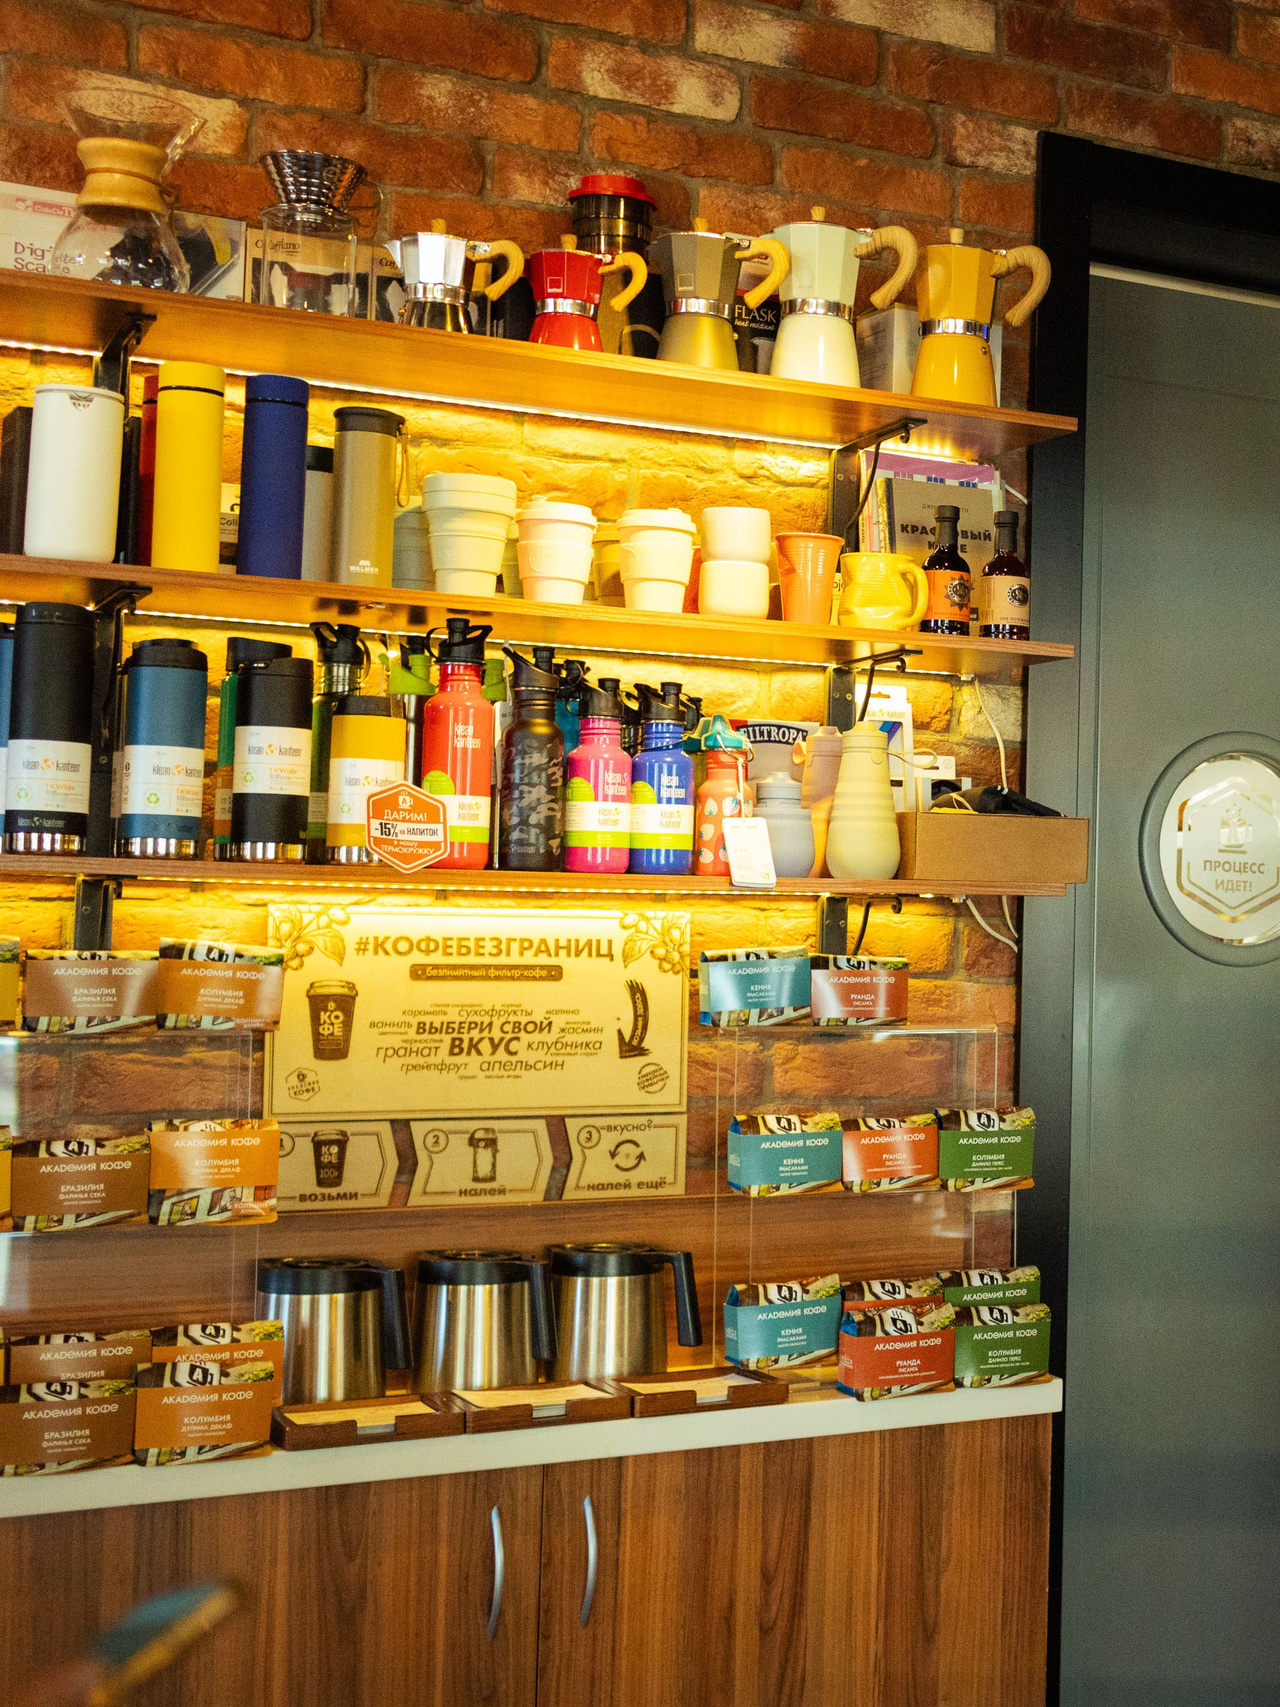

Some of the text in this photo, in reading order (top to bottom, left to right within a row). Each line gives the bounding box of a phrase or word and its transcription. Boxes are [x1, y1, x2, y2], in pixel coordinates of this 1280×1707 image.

[735, 305, 777, 323] FLASK
[900, 523, 992, 542] КРАФВЫЙ
[927, 540, 968, 553] КЕ
[350, 565, 378, 574] WALMER
[454, 722, 474, 736] klean
[453, 735, 482, 749] kanteen
[247, 744, 303, 759] klean kanteen
[22, 757, 40, 771] klean
[152, 763, 171, 777] klean
[344, 775, 361, 787] klean
[604, 770, 622, 784] klean
[660, 773, 679, 787] klean
[604, 783, 627, 796] kanteen
[660, 787, 686, 799] kanteen
[383, 809, 428, 822] ДАРИМ!
[374, 821, 399, 838] -15%
[406, 827, 439, 837] НАПИТОК
[381, 844, 435, 855] ТЕРМОКРУЖКУ
[1203, 859, 1266, 874] ПРОЦЕСС
[1214, 879, 1253, 893] ИДЕТ!
[354, 936, 615, 962] #КОФЕБЕЗГРАНИЦ
[425, 965, 548, 980] безлимитный фильтр-кофе
[73, 987, 117, 995] БРАЗИЛИЯ
[200, 988, 244, 998] КОЛУМБИЯ
[320, 1010, 344, 1024] КО
[402, 1008, 448, 1019] карамель
[458, 1004, 534, 1021] сухофрукты
[545, 1007, 580, 1016] малина
[318, 1023, 343, 1036] ФЕ
[369, 1020, 413, 1030] ваниль
[415, 1020, 494, 1035] ВЫБЕРИ
[499, 1016, 553, 1035] СВОЙ
[558, 1024, 604, 1035] жасмин
[375, 1035, 604, 1064] гранат ВКУС клубника
[400, 1058, 565, 1075] грейпфрут апельсин
[606, 1119, 653, 1136] вкусно?
[432, 1134, 441, 1145] 2
[321, 1144, 339, 1154] КО
[195, 1158, 240, 1167] КОЛУМБИЯ
[321, 1153, 339, 1164] ФЕ
[972, 1153, 1005, 1161] КОЛУМБИЯ
[61, 1183, 105, 1193] БРАЗИЛИЯ
[459, 1184, 507, 1198] налей
[586, 1177, 667, 1192] налей ещё
[781, 1327, 803, 1336] КЕНИЯ
[988, 1348, 1022, 1357] КОЛУМБИЯ
[895, 1359, 921, 1367] РУАНДА
[60, 1370, 105, 1380] БРАЗИЛИЯ
[183, 1414, 231, 1424] КОЛУМБИЯ
[44, 1428, 91, 1440] БРАЗИЛИЯ
